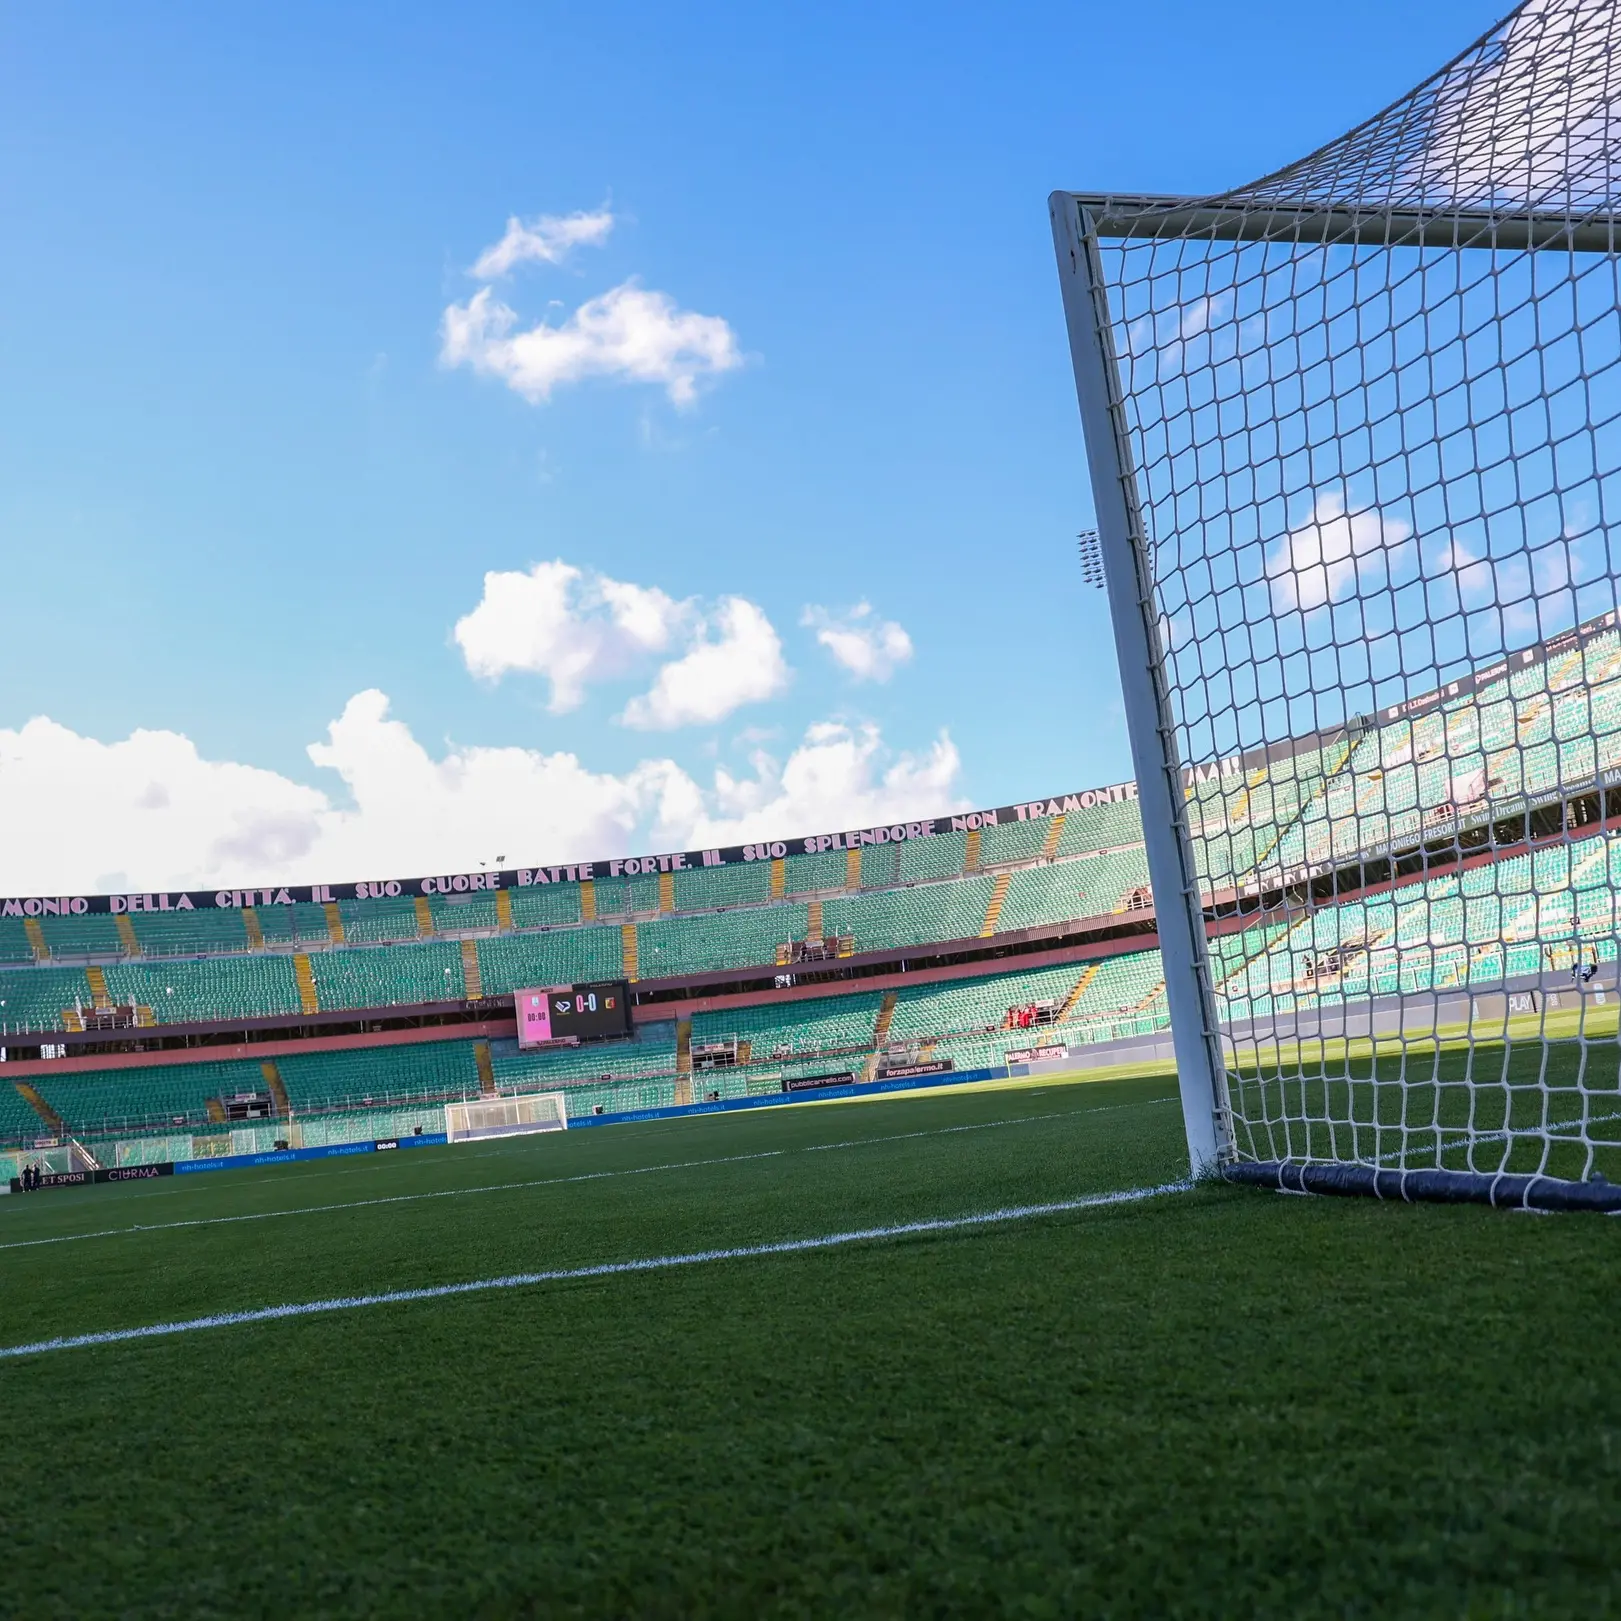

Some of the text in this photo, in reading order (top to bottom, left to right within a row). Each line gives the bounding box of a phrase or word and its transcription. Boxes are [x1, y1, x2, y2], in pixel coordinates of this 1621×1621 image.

[2, 897, 88, 916] MONIO
[110, 893, 194, 913] DELLA
[312, 886, 335, 902] IL
[356, 881, 401, 899] SUO
[421, 872, 500, 894] CUORE
[517, 863, 593, 886] BATTE
[610, 854, 692, 877] FORTE.
[702, 850, 726, 866] IL
[743, 842, 787, 861] SUO
[804, 820, 936, 853] SPLENDORE
[952, 810, 998, 832] NON
[886, 1062, 943, 1077] forzapalermo.it
[57, 1173, 85, 1184] SPOSI
